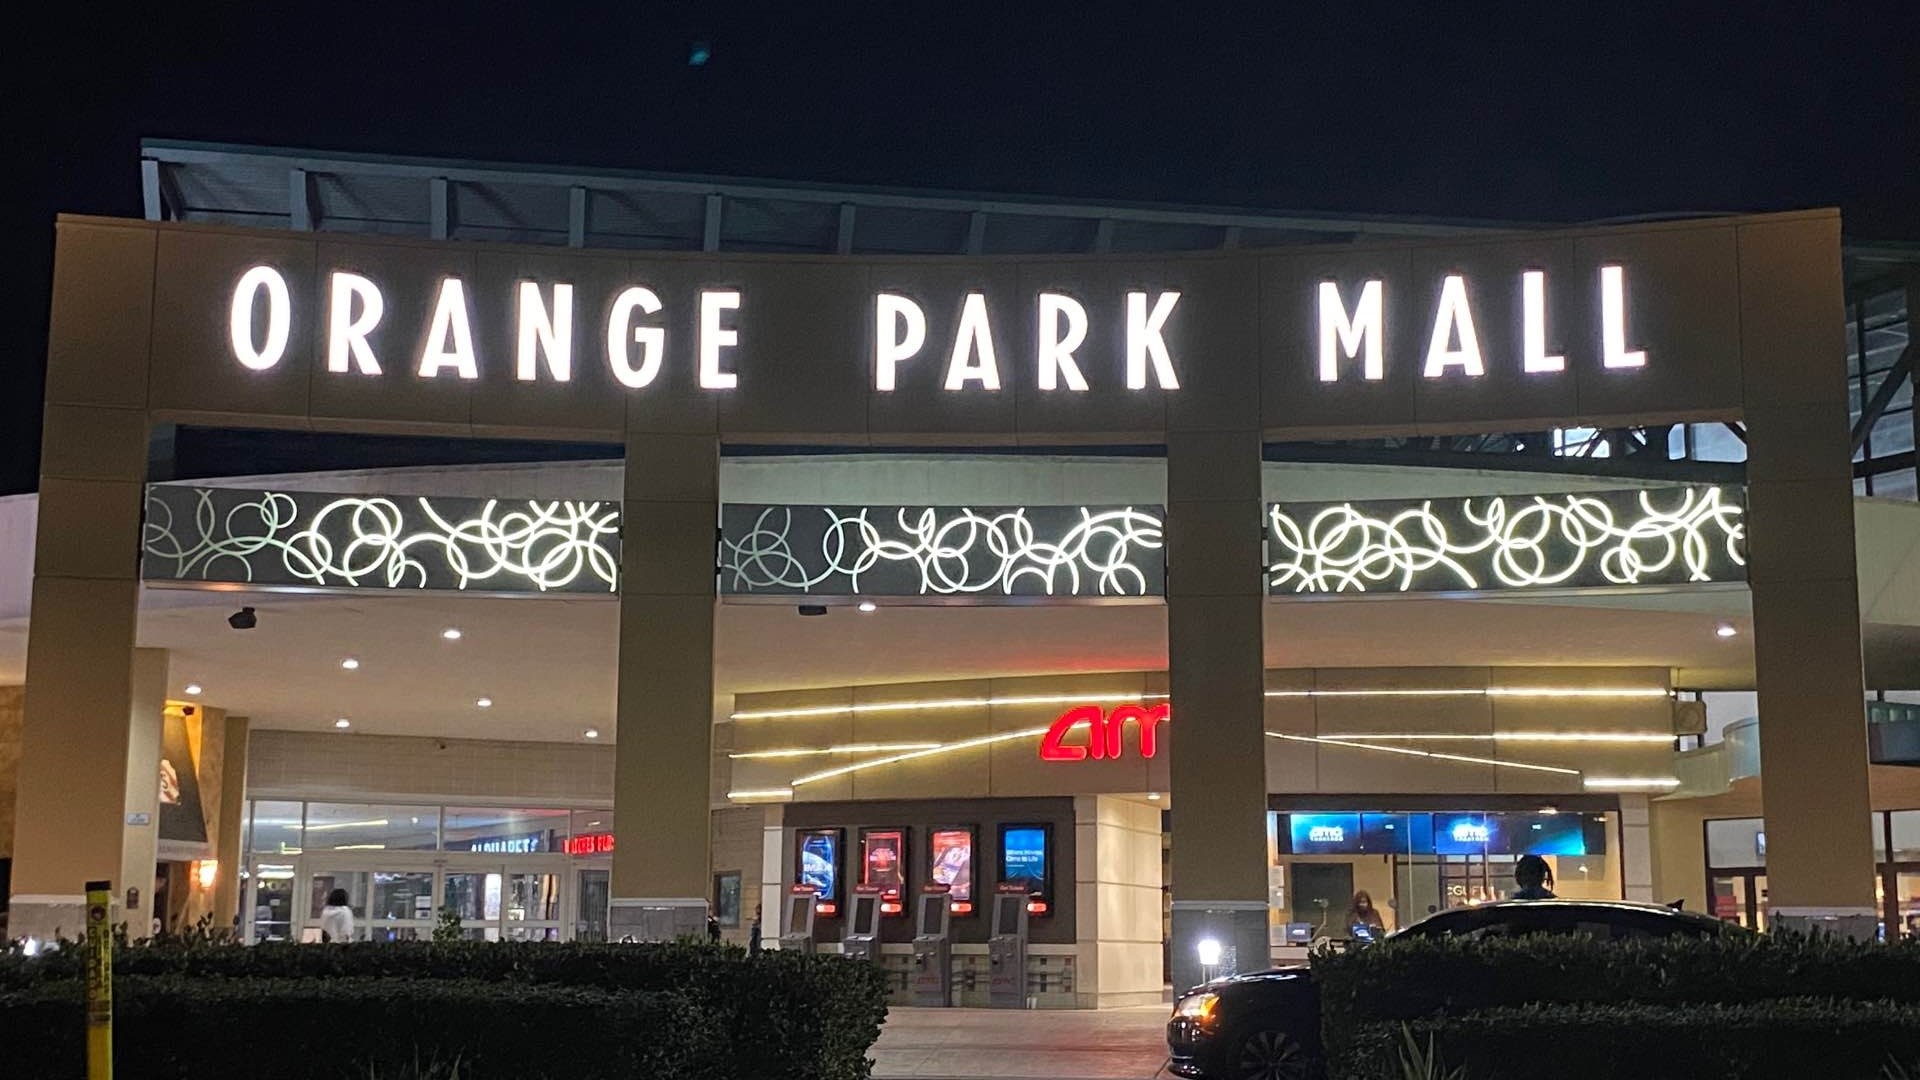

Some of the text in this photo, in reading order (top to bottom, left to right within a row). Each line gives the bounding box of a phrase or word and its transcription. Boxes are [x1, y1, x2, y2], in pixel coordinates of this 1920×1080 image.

[230, 266, 1646, 391] ORANGE PARK MALL
